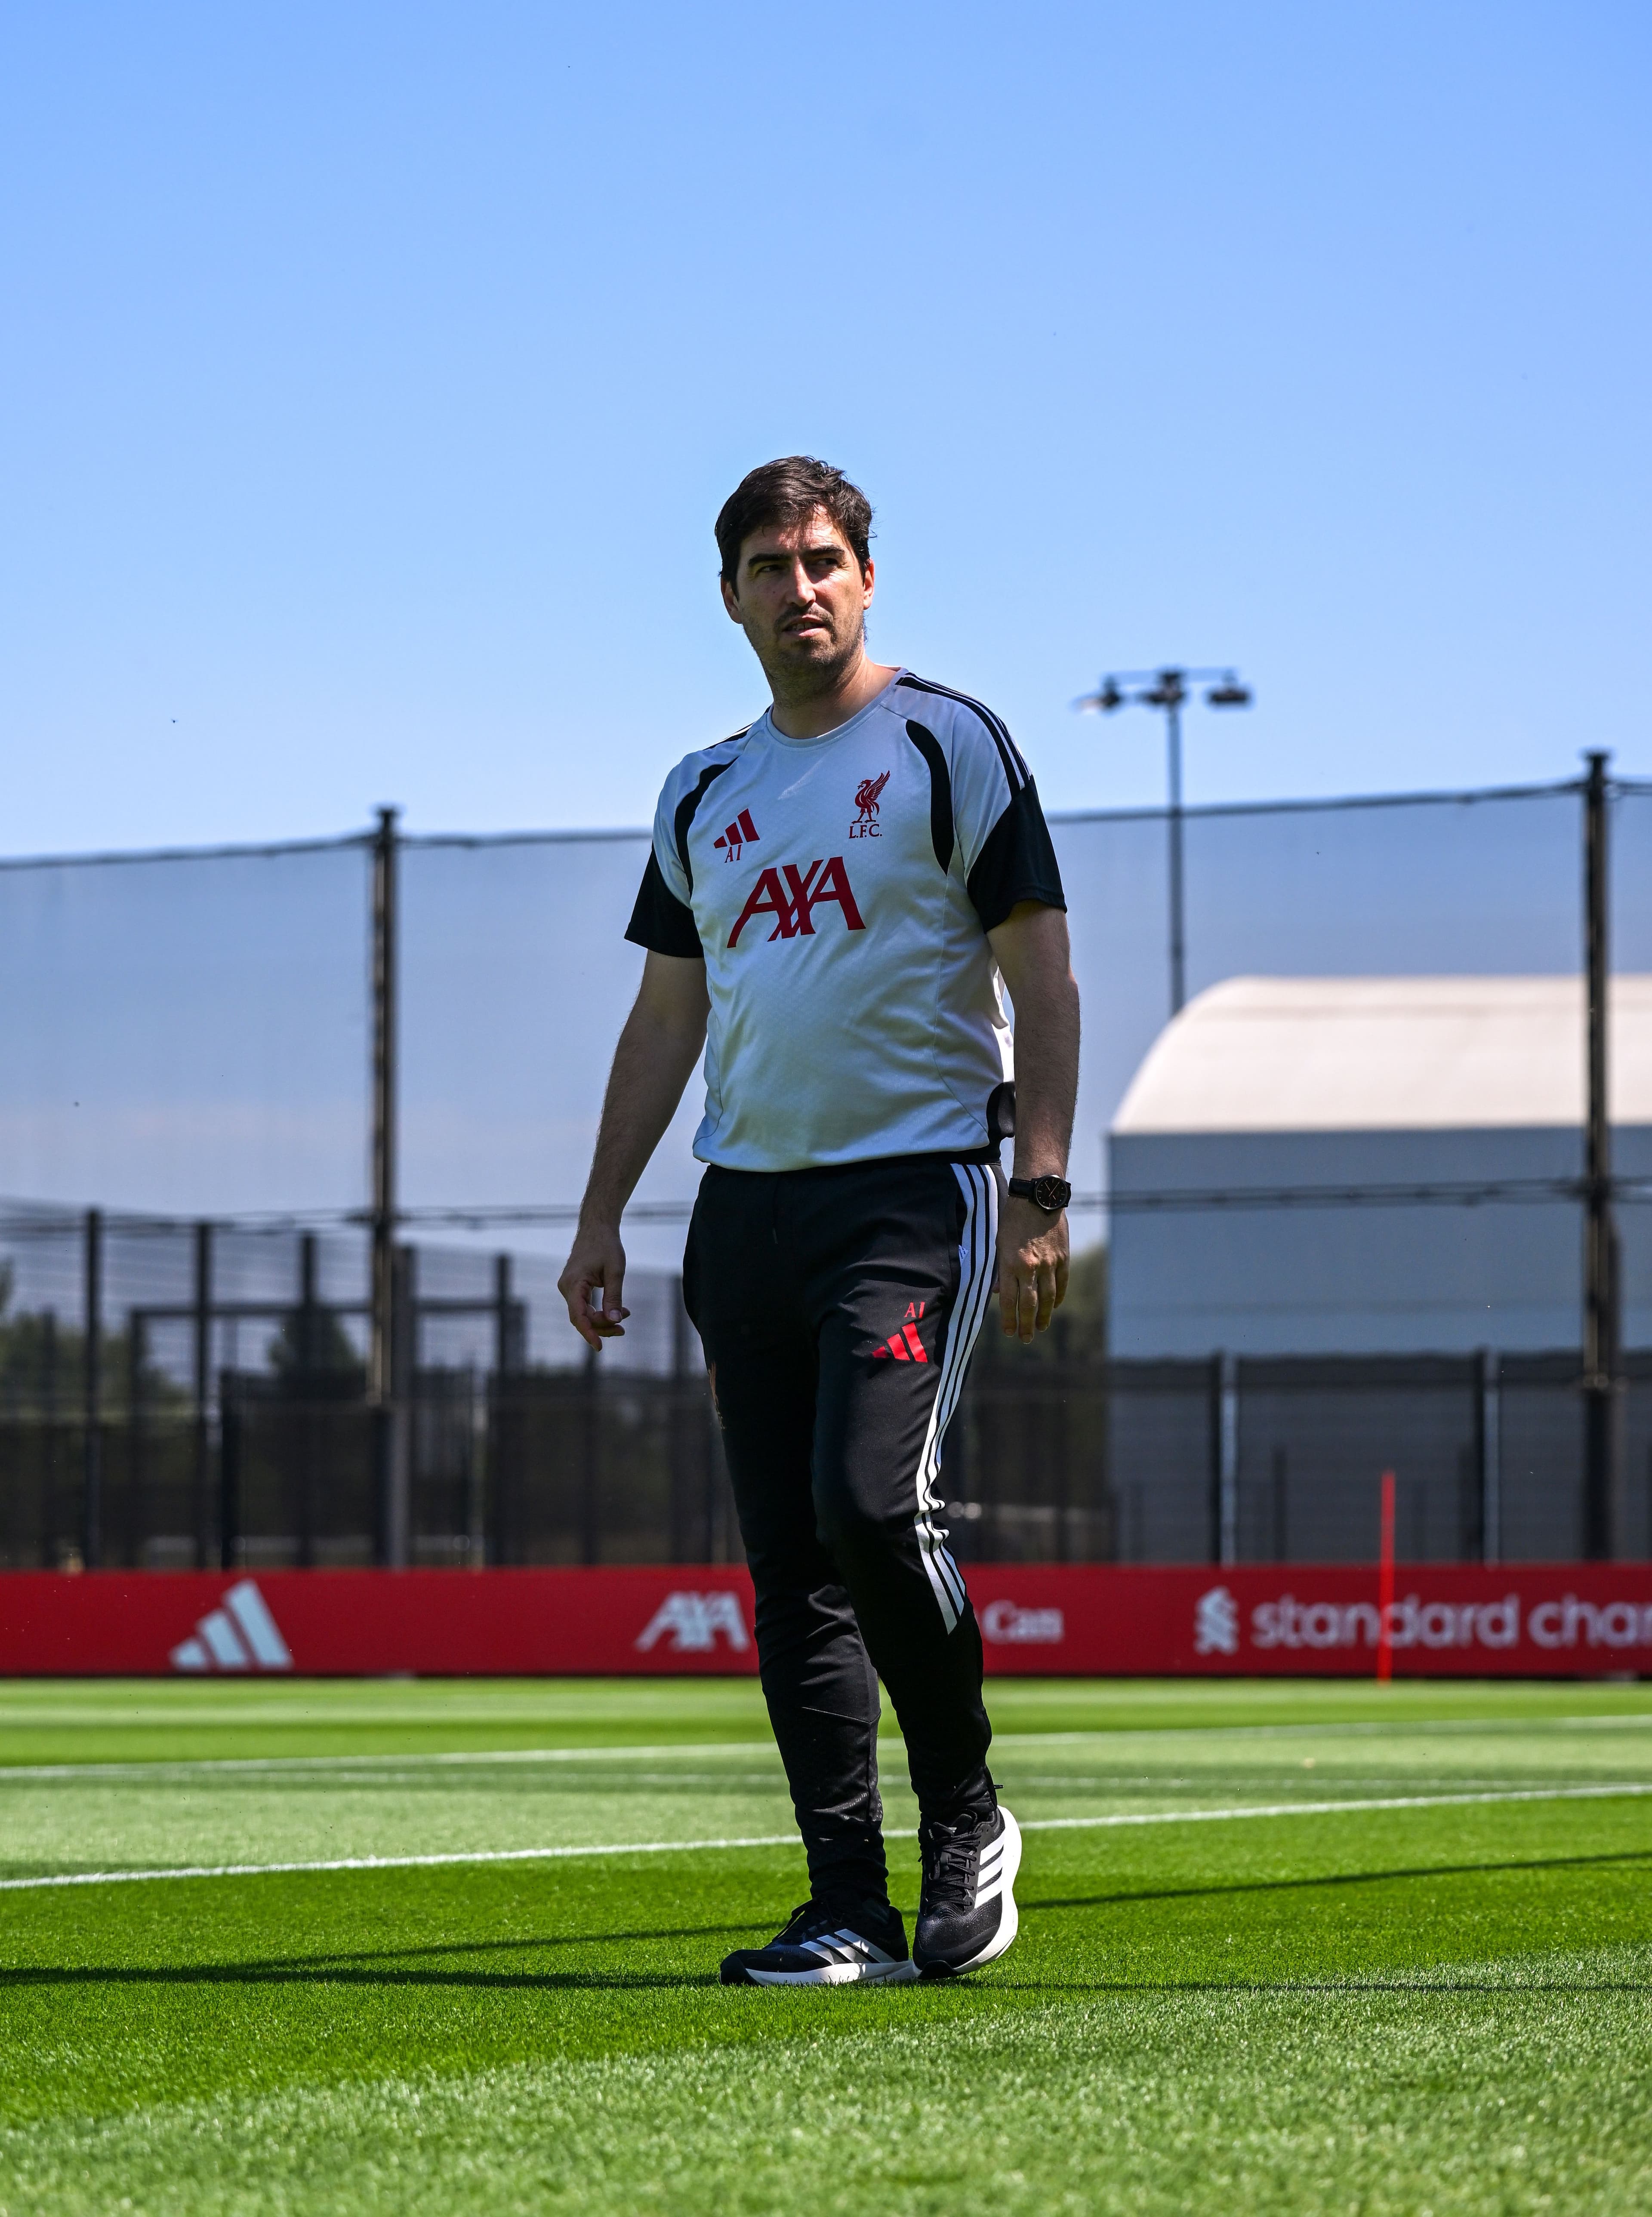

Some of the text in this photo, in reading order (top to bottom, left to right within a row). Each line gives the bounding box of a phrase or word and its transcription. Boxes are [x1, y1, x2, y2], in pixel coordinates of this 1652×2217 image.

[848, 823, 883, 839] L.F.C.
[724, 844, 742, 863] AI
[727, 856, 866, 948] AXA
[904, 1301, 925, 1318] AI
[636, 1592, 749, 1651] AXA
[1251, 1593, 1520, 1649] standard
